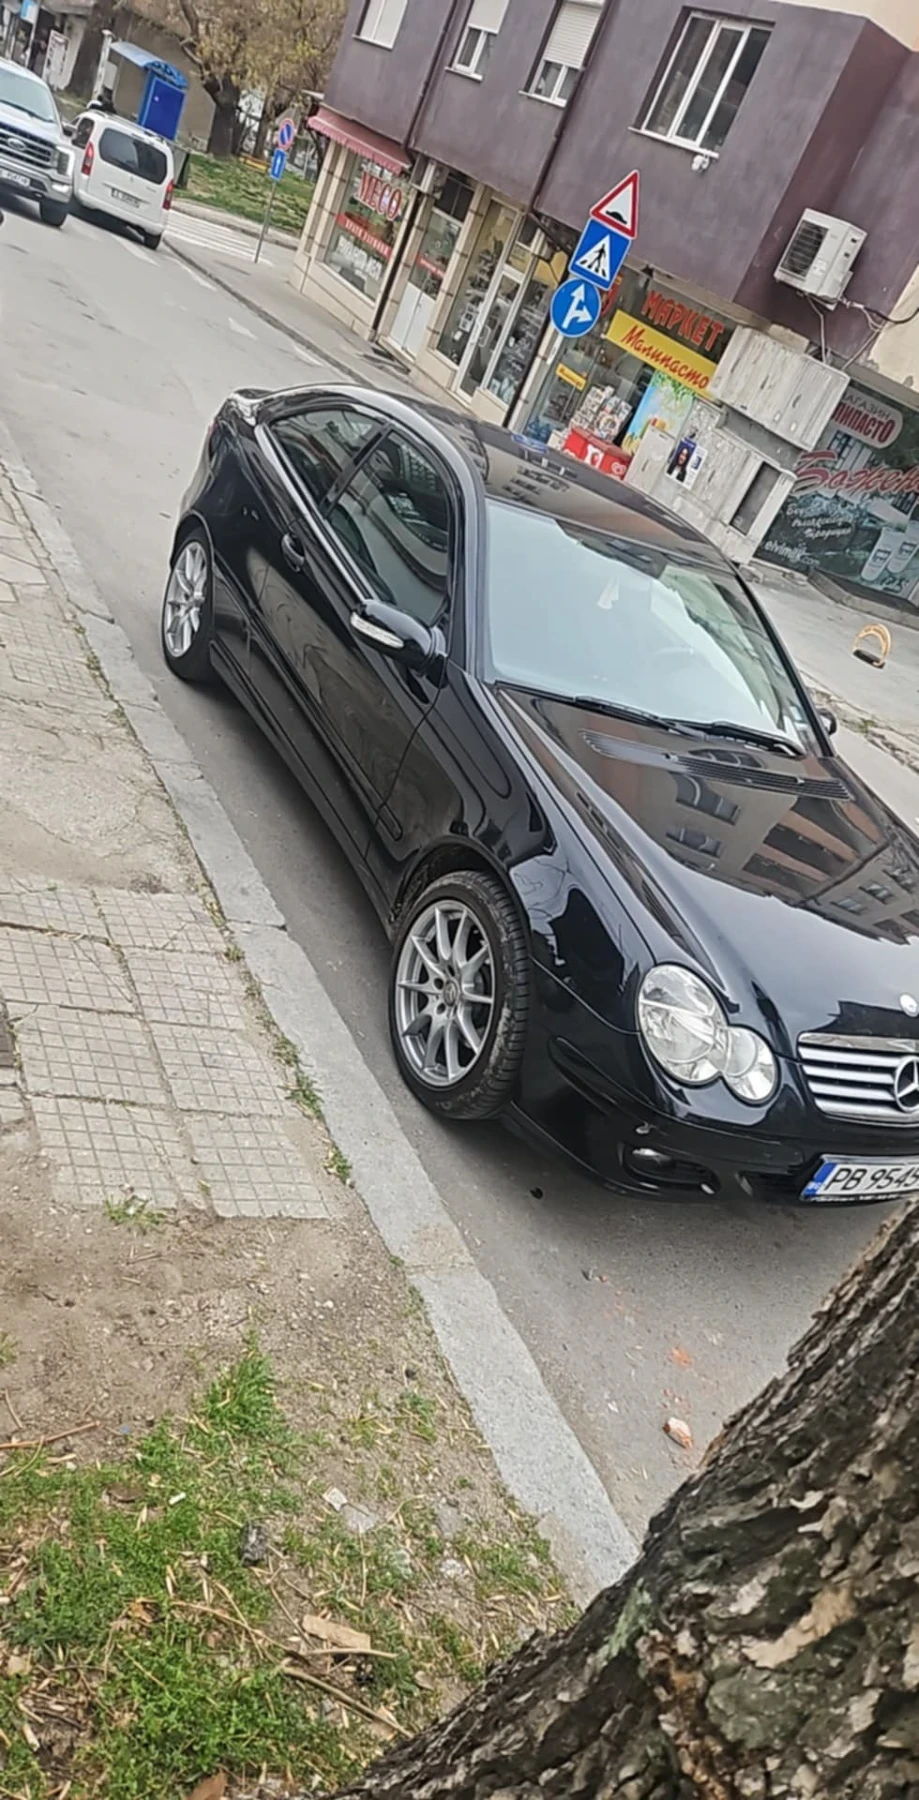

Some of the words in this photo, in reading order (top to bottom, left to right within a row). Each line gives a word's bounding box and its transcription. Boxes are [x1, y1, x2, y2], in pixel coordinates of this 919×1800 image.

[641, 290, 725, 351] МАРКЕТ
[620, 324, 710, 389] Малипасто
[840, 393, 891, 420] АГАЗИН
[824, 1168, 867, 1191] PB
